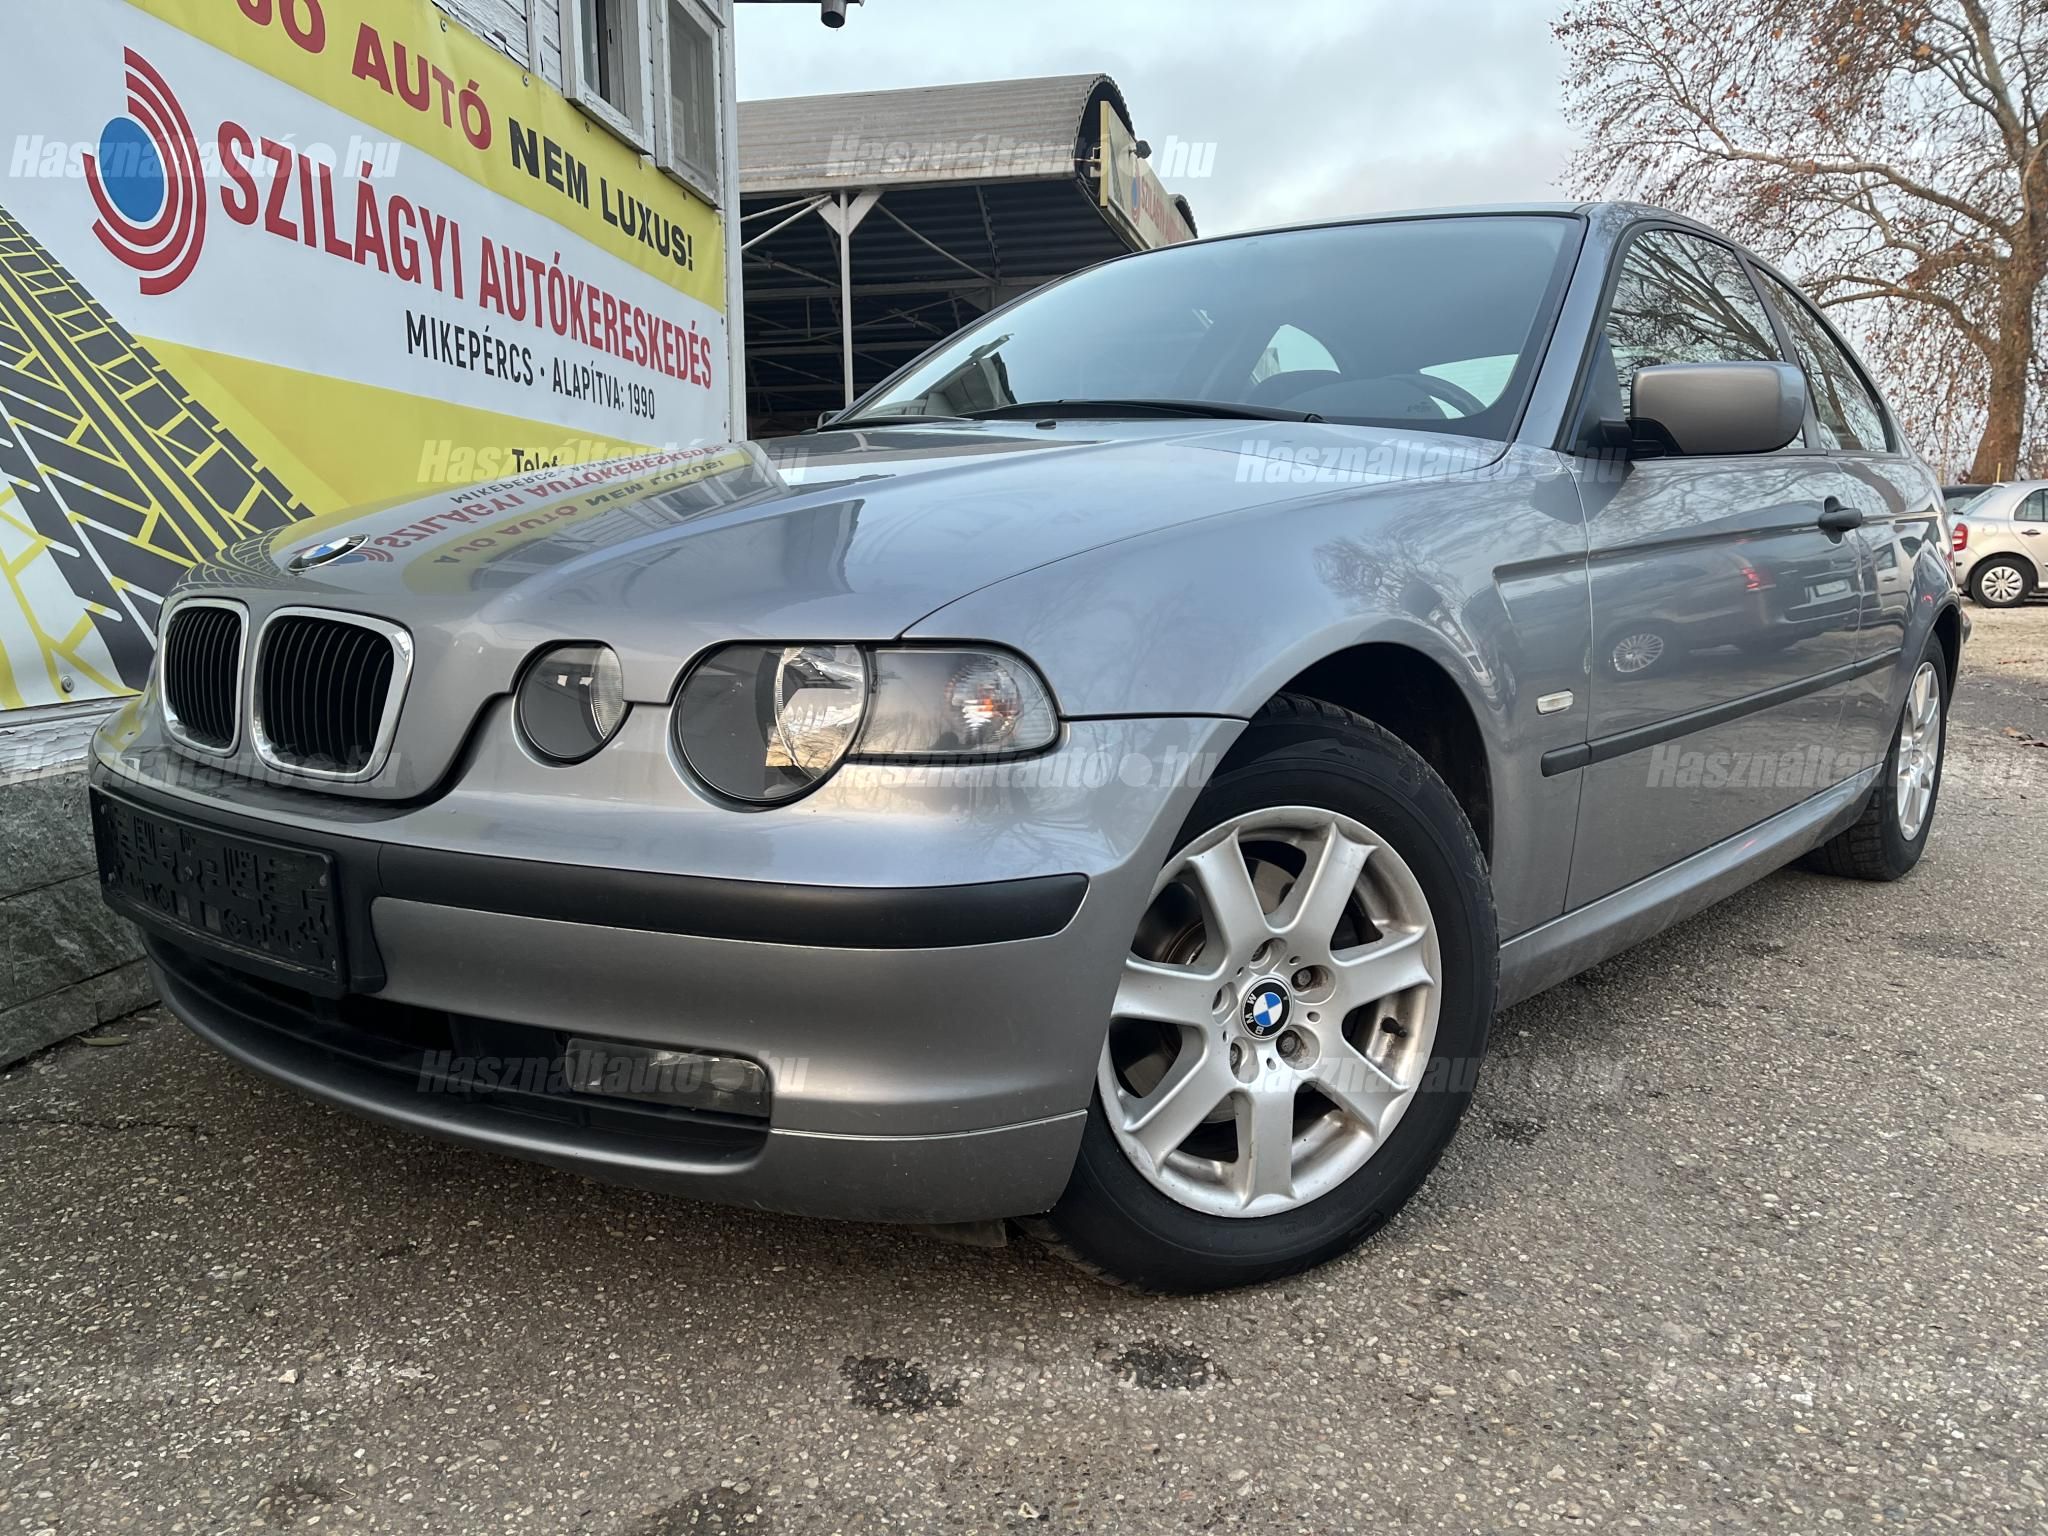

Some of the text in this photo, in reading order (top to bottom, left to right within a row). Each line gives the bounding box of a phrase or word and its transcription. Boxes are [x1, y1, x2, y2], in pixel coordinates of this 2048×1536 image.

[217, 121, 712, 389] SZILÁGYI AUTÓKERESKEDÉS
[352, 22, 492, 150] AUTÓ
[509, 117, 589, 209] NEM
[600, 176, 693, 272] LUXUS!
[406, 309, 656, 420] MIKEPÉRCS ALAPÍTVA: 1990
